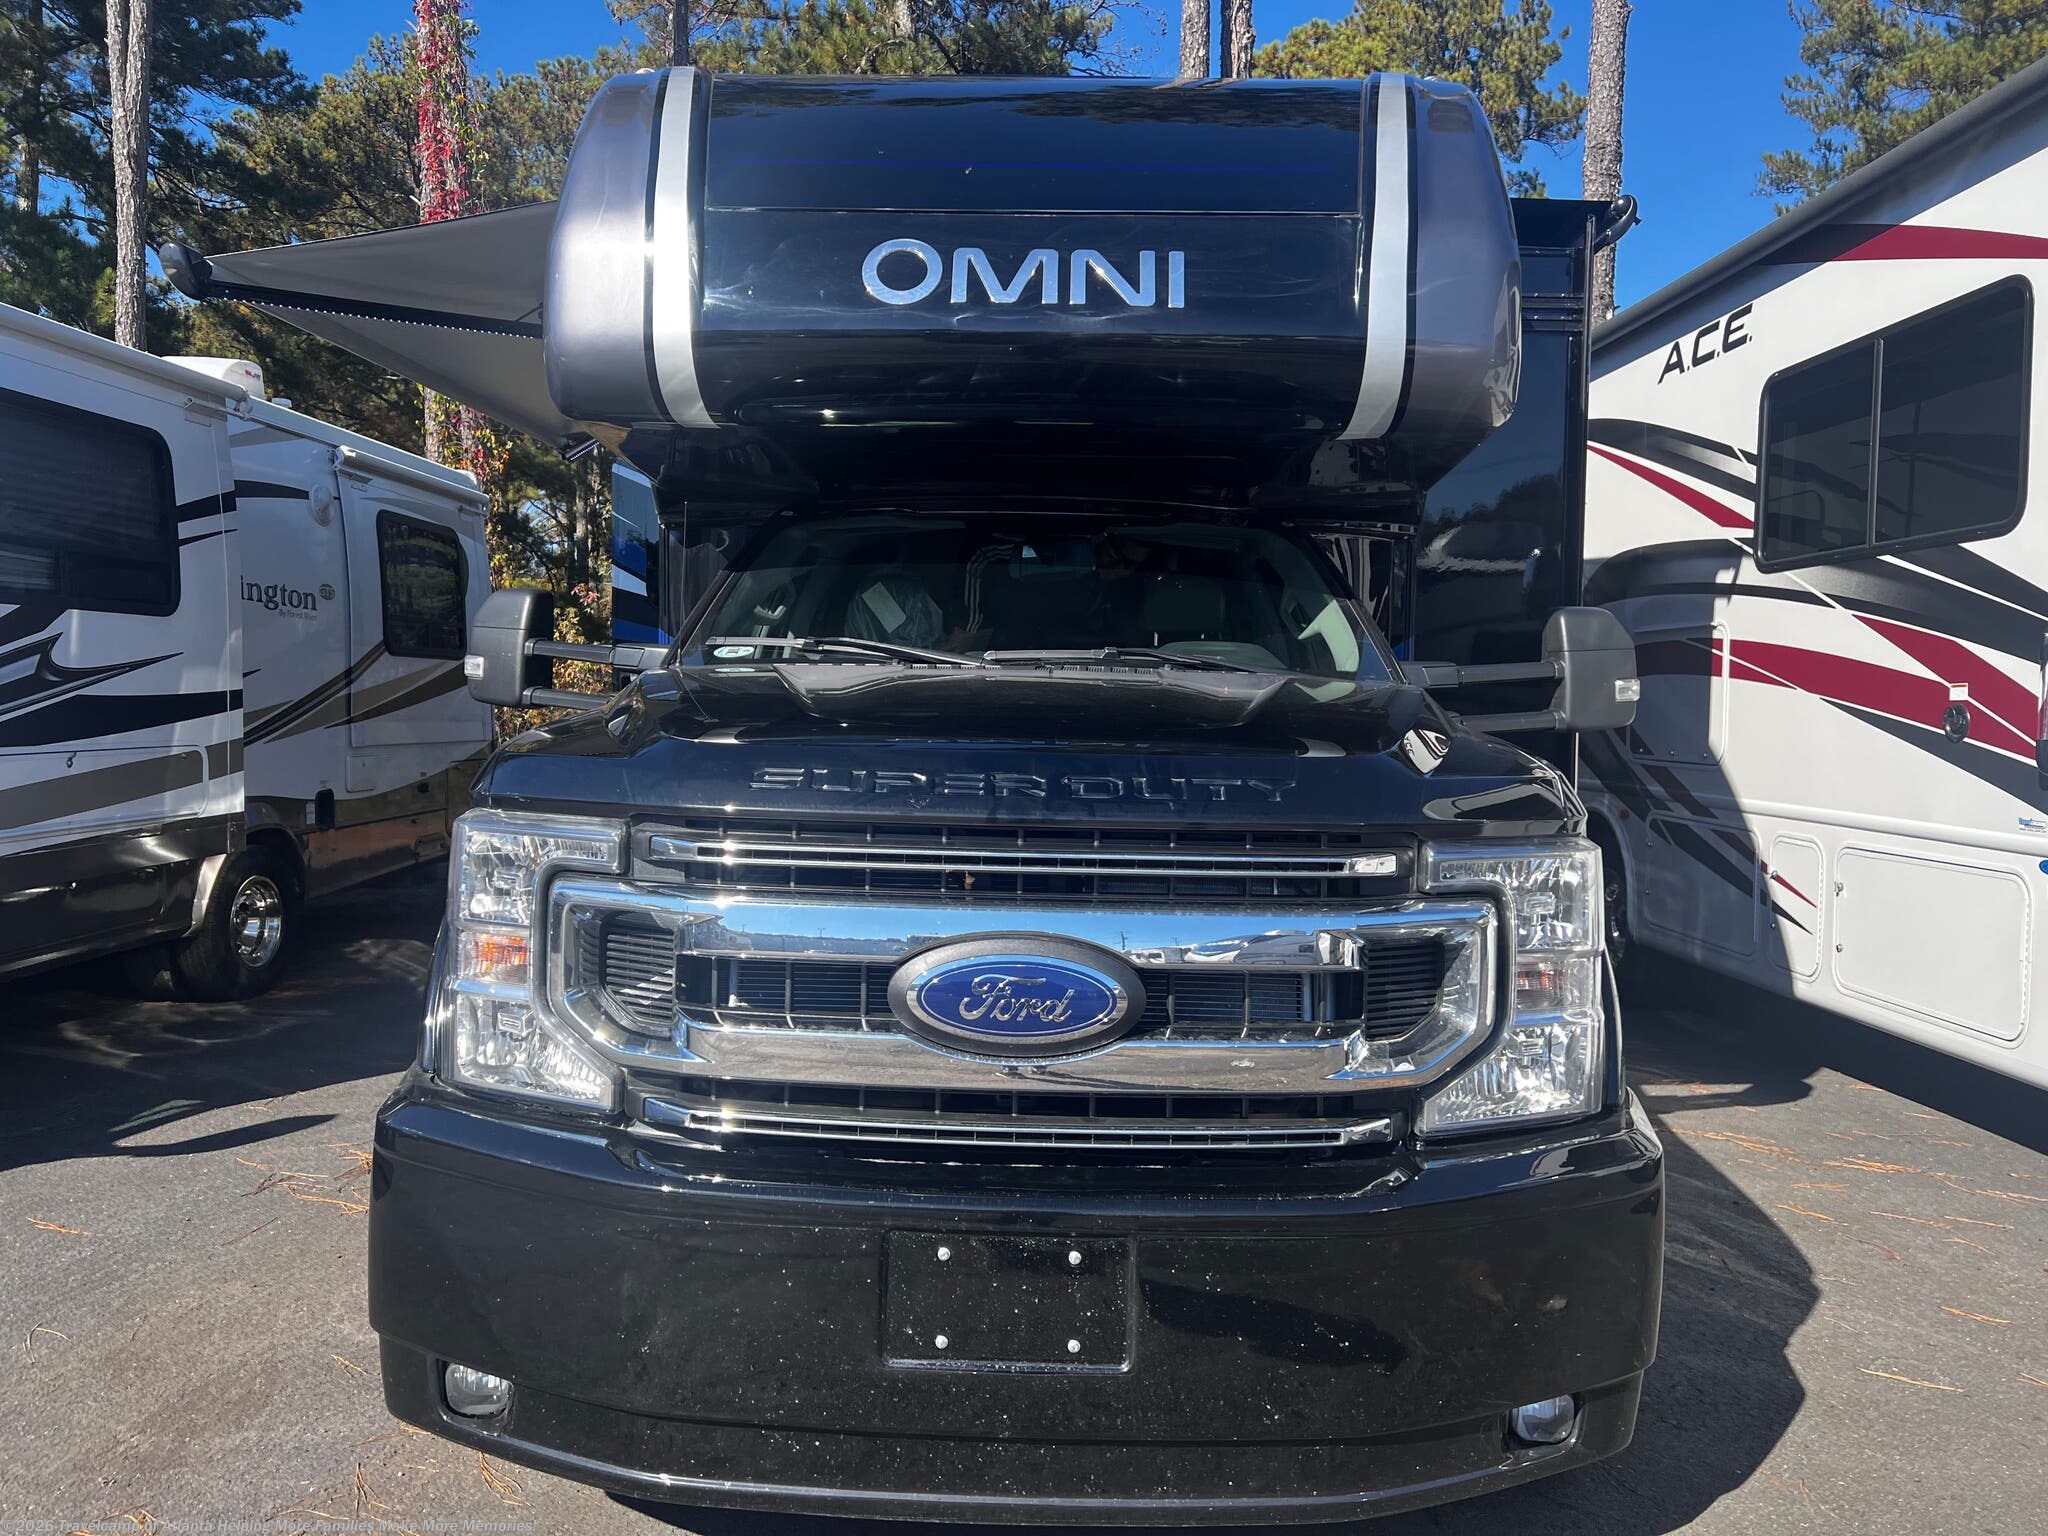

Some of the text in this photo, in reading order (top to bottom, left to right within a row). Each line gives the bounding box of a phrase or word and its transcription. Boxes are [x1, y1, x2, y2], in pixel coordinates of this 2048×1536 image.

[862, 238, 1185, 308] OMNI
[1657, 302, 1754, 385] A.C.E.
[240, 574, 318, 611] ington
[749, 767, 1298, 802] SUPER DUTY
[958, 973, 1076, 1024] Ford
